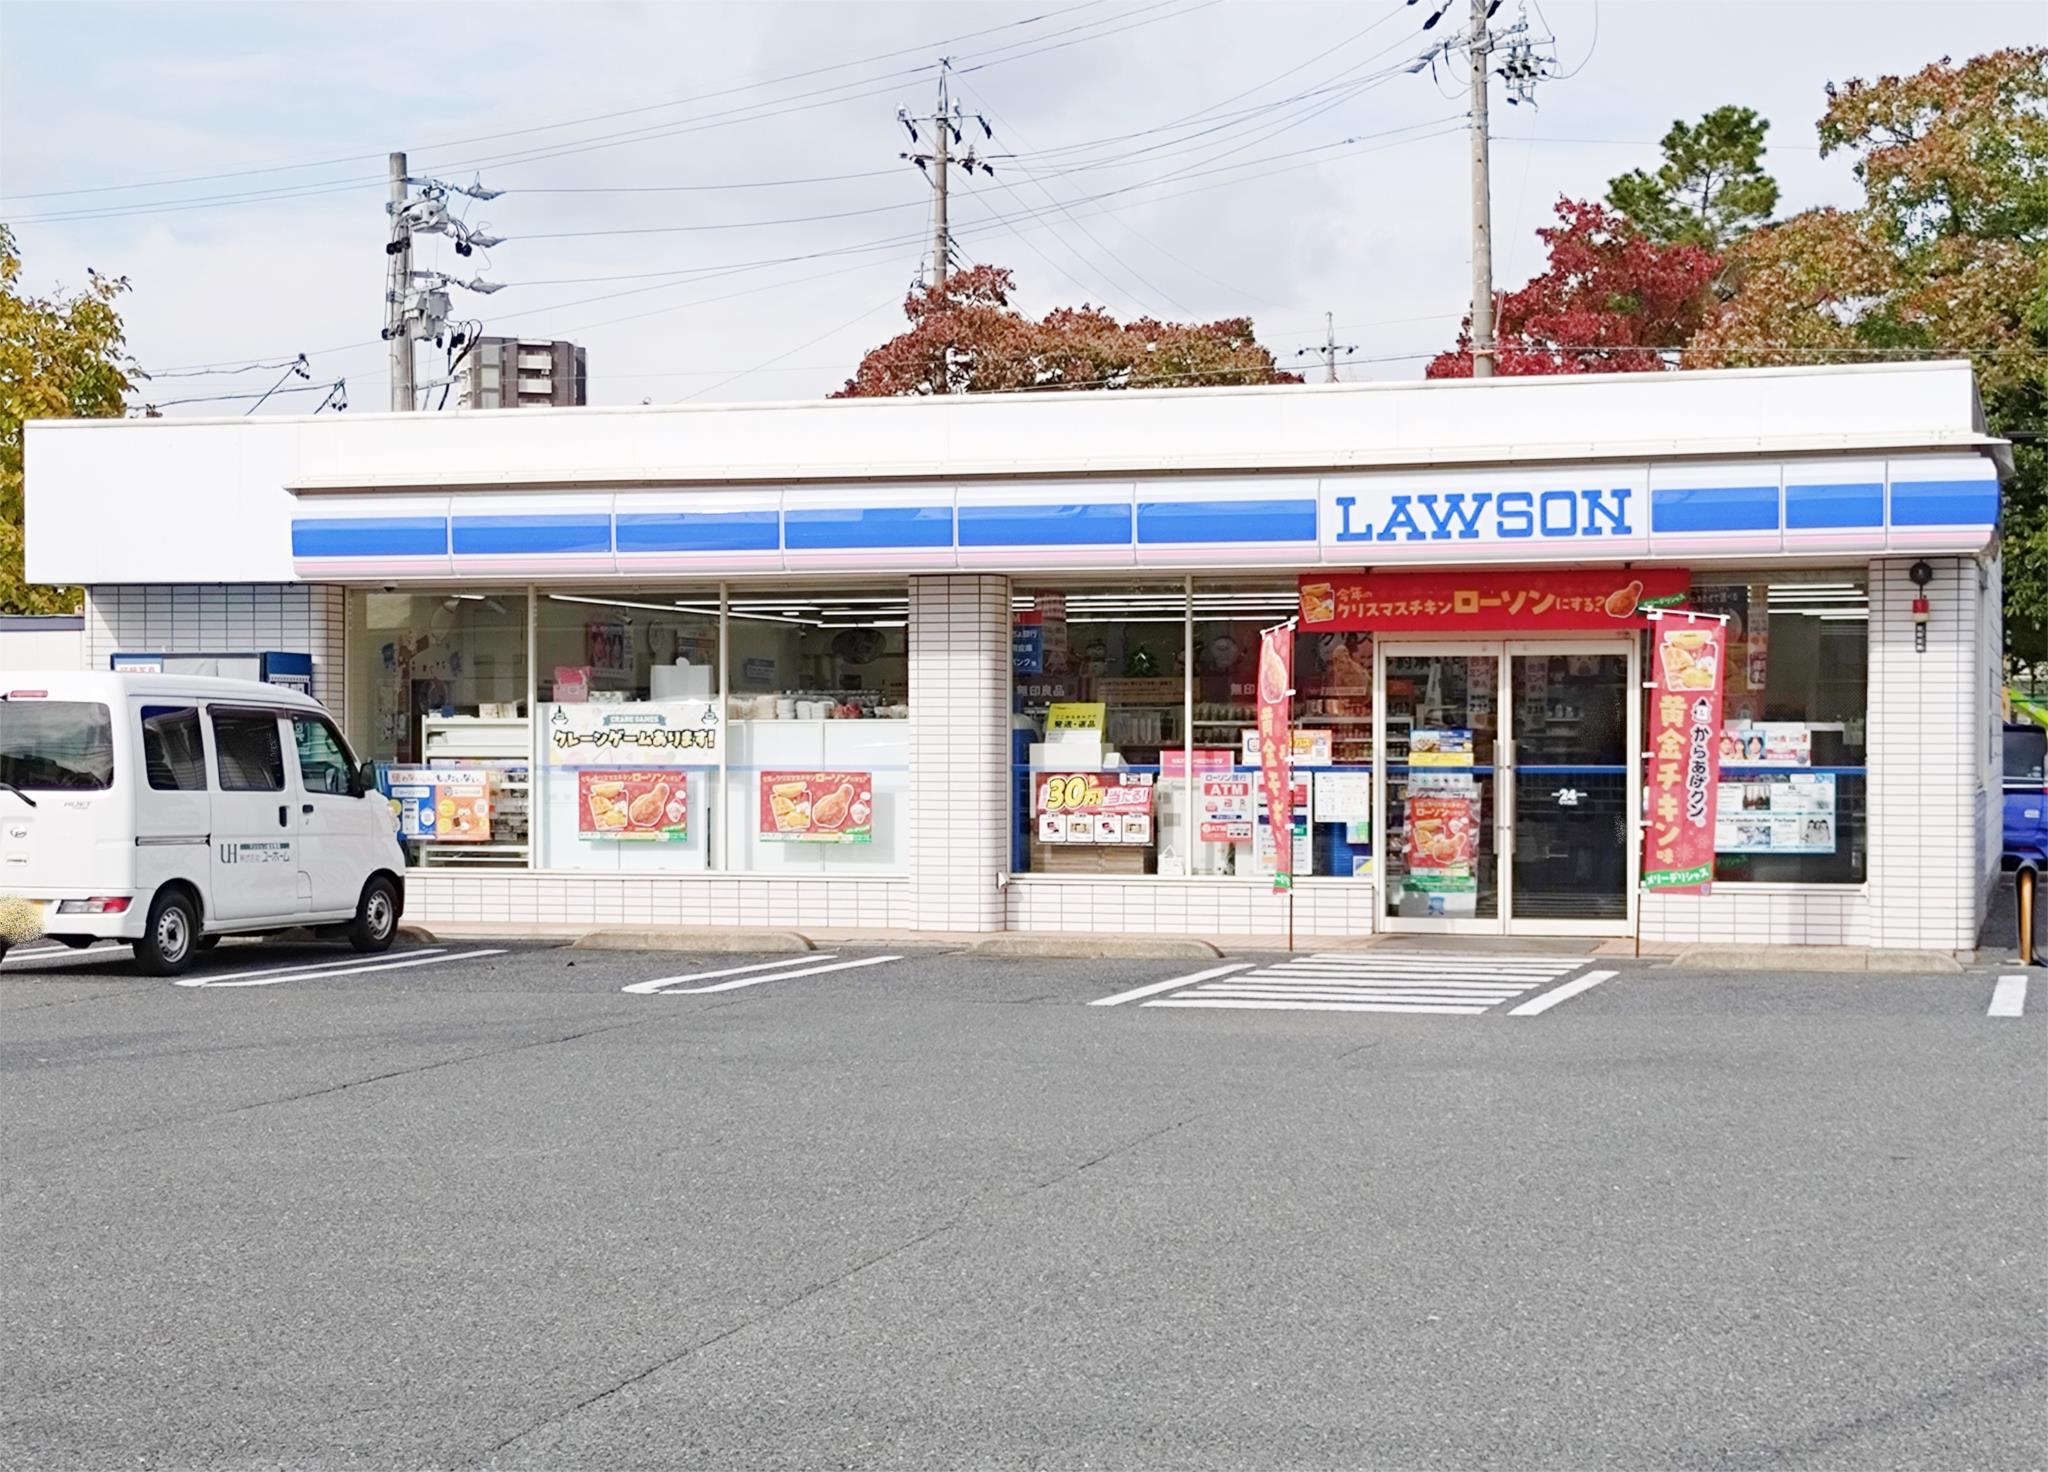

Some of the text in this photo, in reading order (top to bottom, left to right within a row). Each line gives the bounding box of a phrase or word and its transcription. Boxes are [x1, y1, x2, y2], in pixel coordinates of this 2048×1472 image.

[1336, 488, 1632, 542] LAWSON
[1336, 586, 1373, 602] 今年の
[1230, 683, 1256, 696] 無印
[554, 728, 716, 748] クレーンゲームあります!
[1655, 695, 1688, 865] 黄金チキン味
[1688, 725, 1711, 819] からあげクン
[1210, 784, 1244, 796] ATM
[1646, 867, 1710, 885] メリーデリシャス
